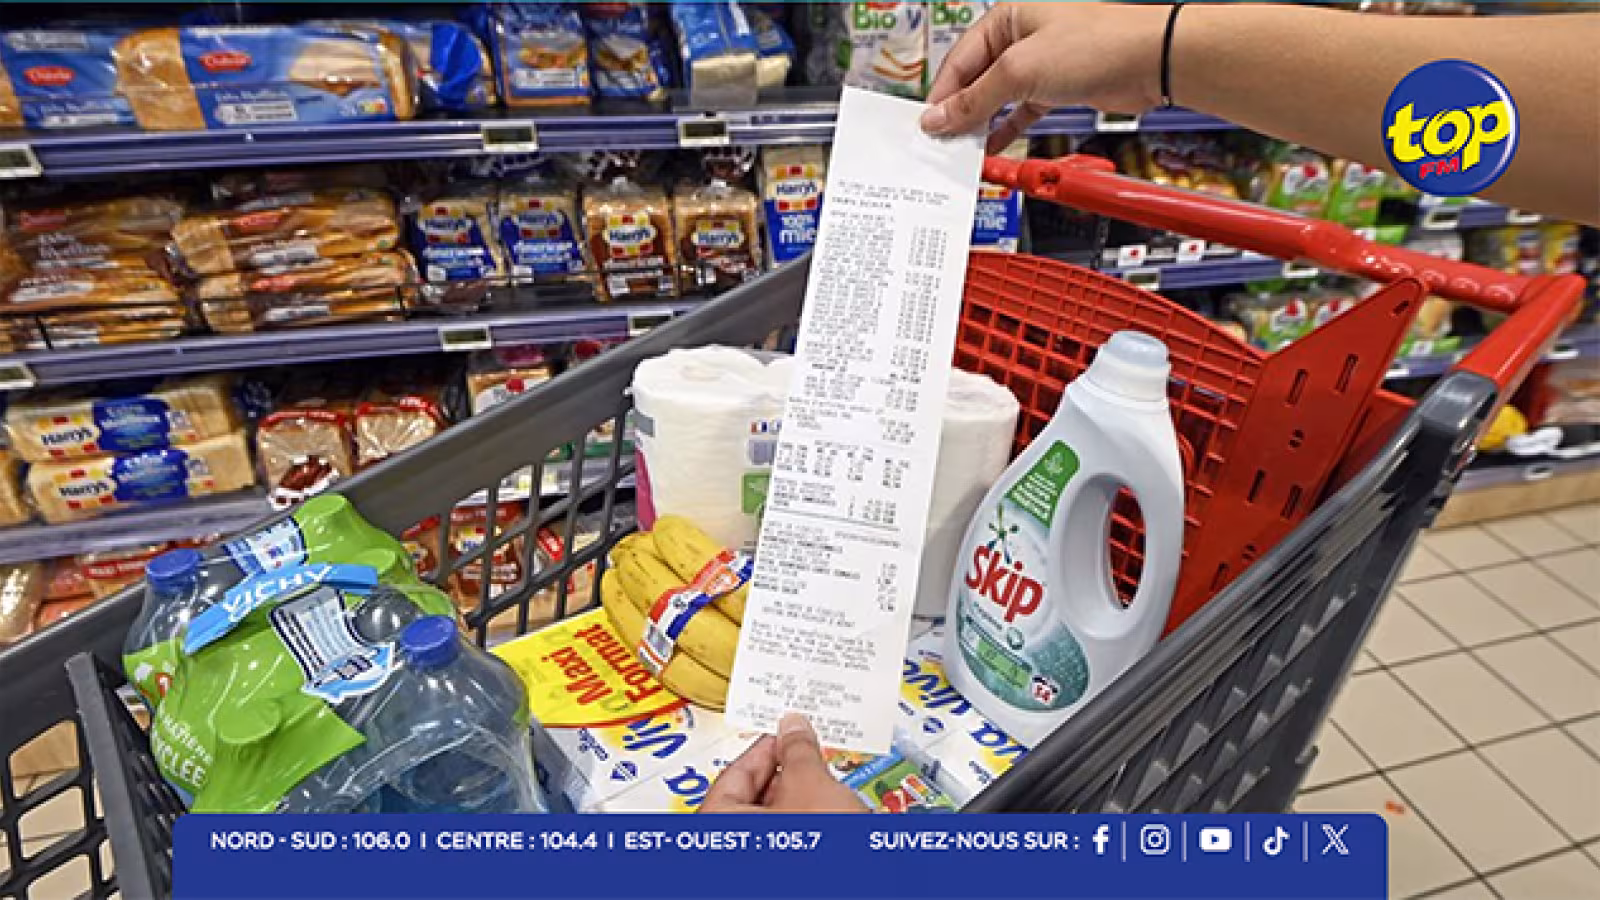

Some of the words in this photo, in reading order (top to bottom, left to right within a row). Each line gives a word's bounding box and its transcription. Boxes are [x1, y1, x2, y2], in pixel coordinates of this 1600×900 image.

[222, 564, 333, 615] VICHY
[964, 544, 1044, 624] Skip
[541, 646, 613, 706] Maxi
[573, 623, 664, 703] Format
